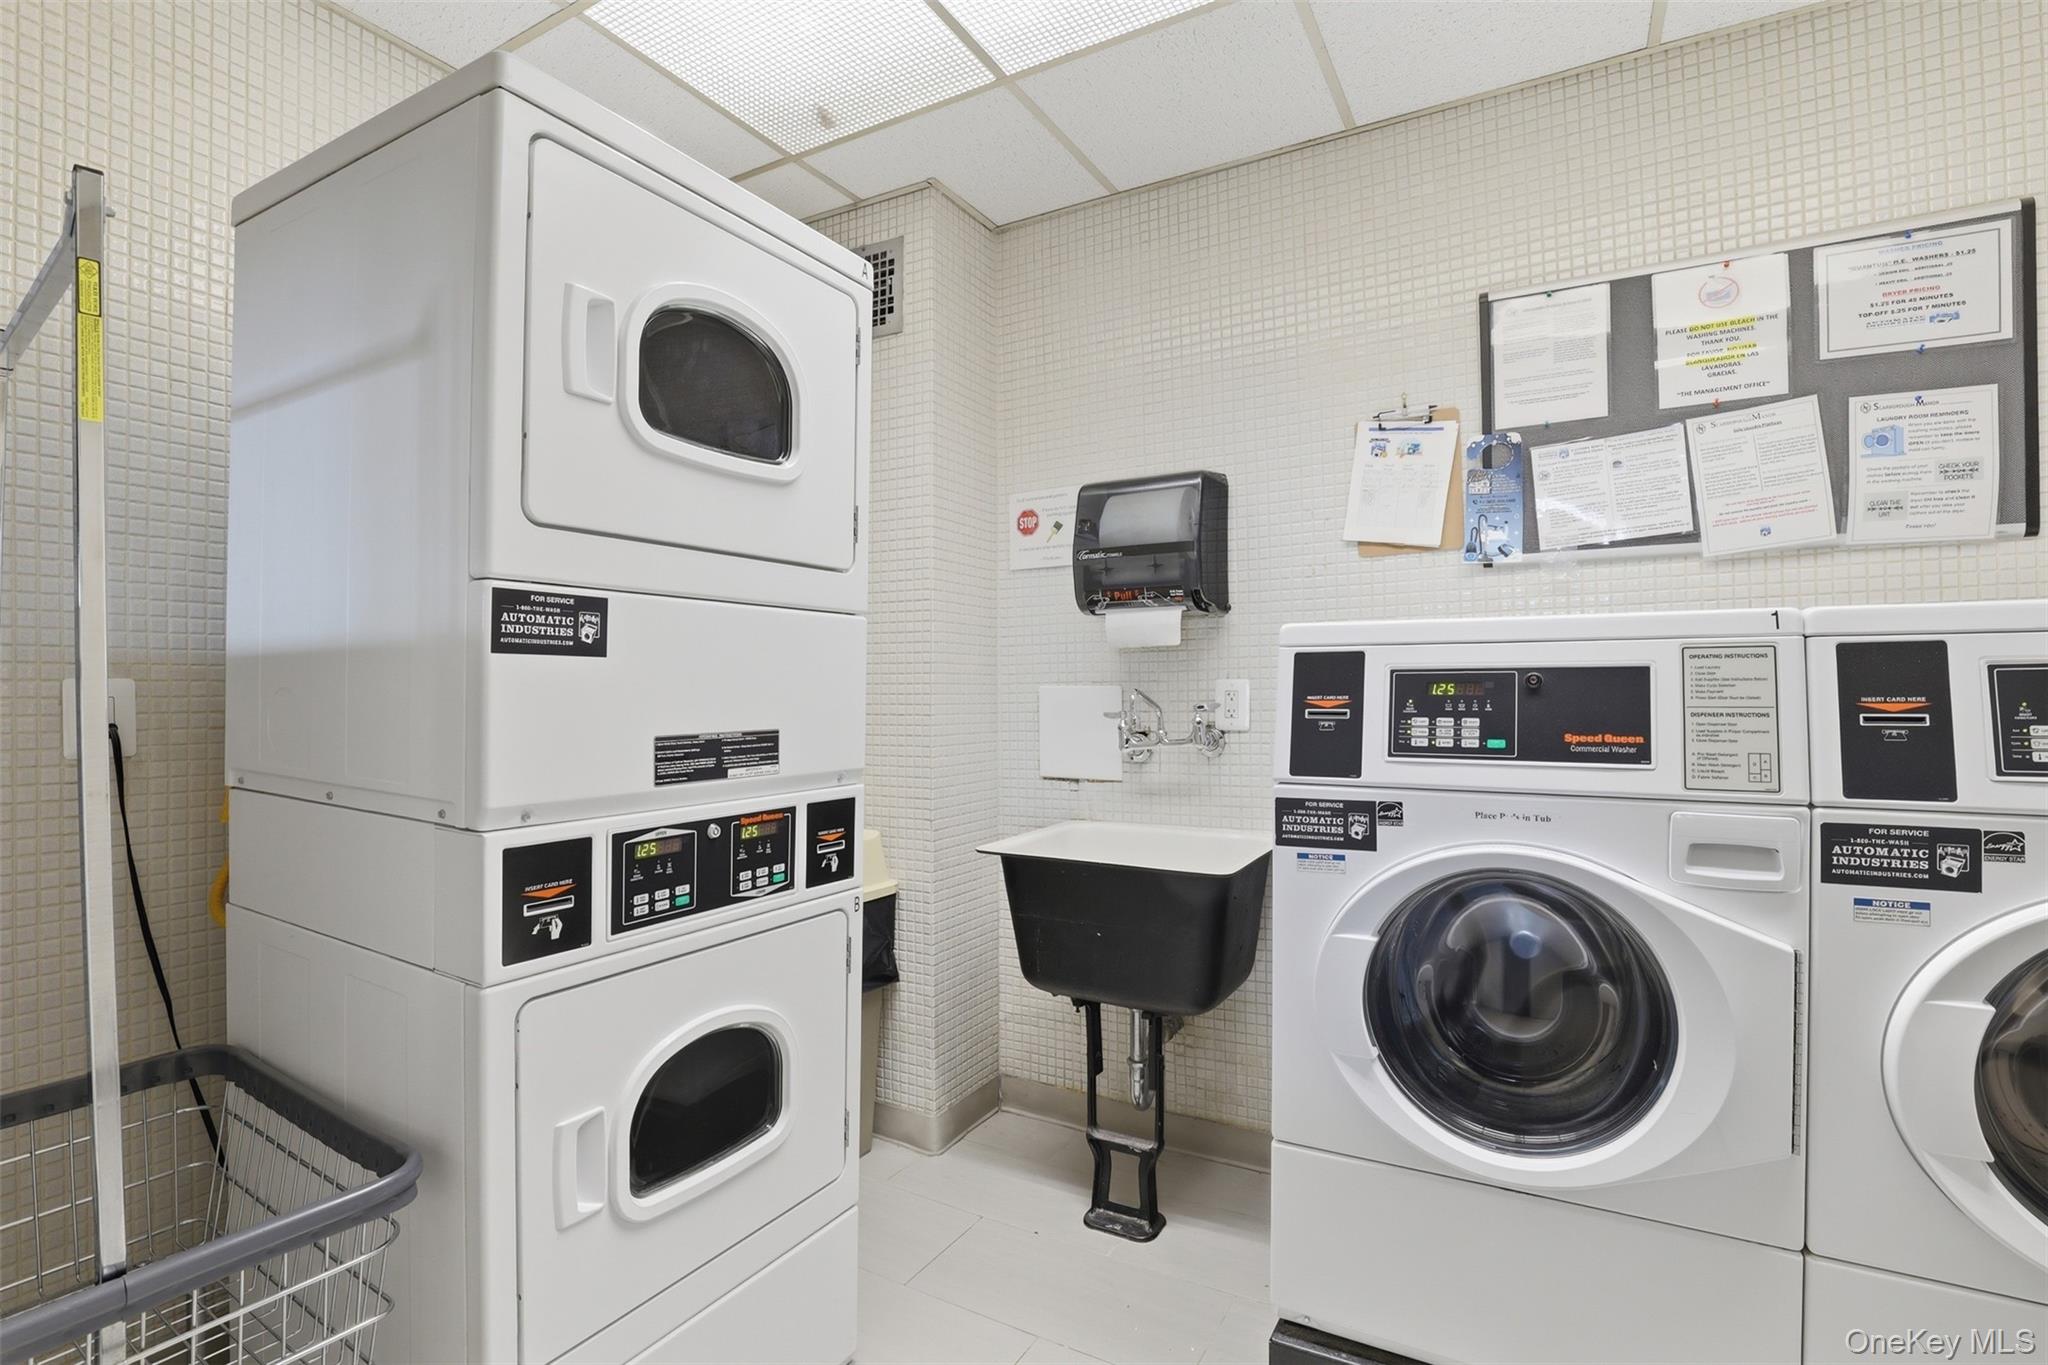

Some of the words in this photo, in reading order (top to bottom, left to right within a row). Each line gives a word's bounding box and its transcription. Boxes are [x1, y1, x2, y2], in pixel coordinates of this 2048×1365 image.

[1911, 252, 1949, 262] WASHERS
[1955, 248, 1976, 257] $1.25
[862, 263, 868, 279] A
[1882, 288, 1907, 298] DRYER
[1909, 284, 1941, 294] PRICING
[1919, 292, 1954, 301] MINUTES
[1907, 304, 1923, 312] FOR
[1931, 299, 1967, 309] MINUTES
[1665, 327, 1688, 336] PLEASE
[1700, 322, 1714, 330] NOT
[1716, 320, 1728, 328] USE
[1730, 316, 1756, 326] BLEACH
[1686, 330, 1719, 340] WASHING
[1701, 337, 1724, 346] THANK
[1746, 350, 1759, 358] LAS
[1693, 383, 1742, 395] MANAGEMENT
[1877, 414, 1906, 422] LAUNDRY
[1908, 412, 1929, 420] ROOM
[1930, 409, 1969, 418] REMINDERS
[1938, 462, 1960, 471] CHECK
[1961, 460, 1980, 469] YOUR
[1944, 472, 1974, 481] POCKETS
[1019, 516, 1037, 529] STOP
[546, 596, 575, 605] SERVICE
[1113, 590, 1134, 601] Pull
[516, 604, 560, 613] 1-800-THE-WASH
[501, 612, 574, 625] AUTOMATIC
[1771, 610, 1780, 630] 1
[501, 624, 574, 637] INDUSTRIES
[500, 637, 574, 646] AUTOMATICINDUSTRIES.COM
[1564, 733, 1602, 744] Speed
[1604, 733, 1644, 743] Queen
[1570, 745, 1610, 753] Commercial
[1611, 746, 1637, 754] Washer
[1282, 815, 1344, 825] AUTOMATIC
[1474, 811, 1498, 820] Place
[1522, 814, 1531, 822] in
[1534, 814, 1552, 822] Tub
[1282, 824, 1344, 834] INDUSTRIES
[1868, 828, 1887, 836] FOR
[1889, 829, 1929, 838] SERVICE
[1282, 834, 1344, 842] AUTOMATICINDUSTRIES.COM
[1850, 837, 1910, 846] 1-800-THE-WASH
[1308, 853, 1333, 861] NOTICE
[1832, 845, 1929, 859] AUTOMATIC
[1832, 856, 1929, 870] INDUSTRIES
[1832, 869, 1929, 879] AUTOMATICINDUSTRIES.COM
[525, 884, 543, 892] INSERT
[544, 881, 558, 889] CARD
[854, 896, 860, 912] B
[1872, 900, 1911, 910] NOTICE
